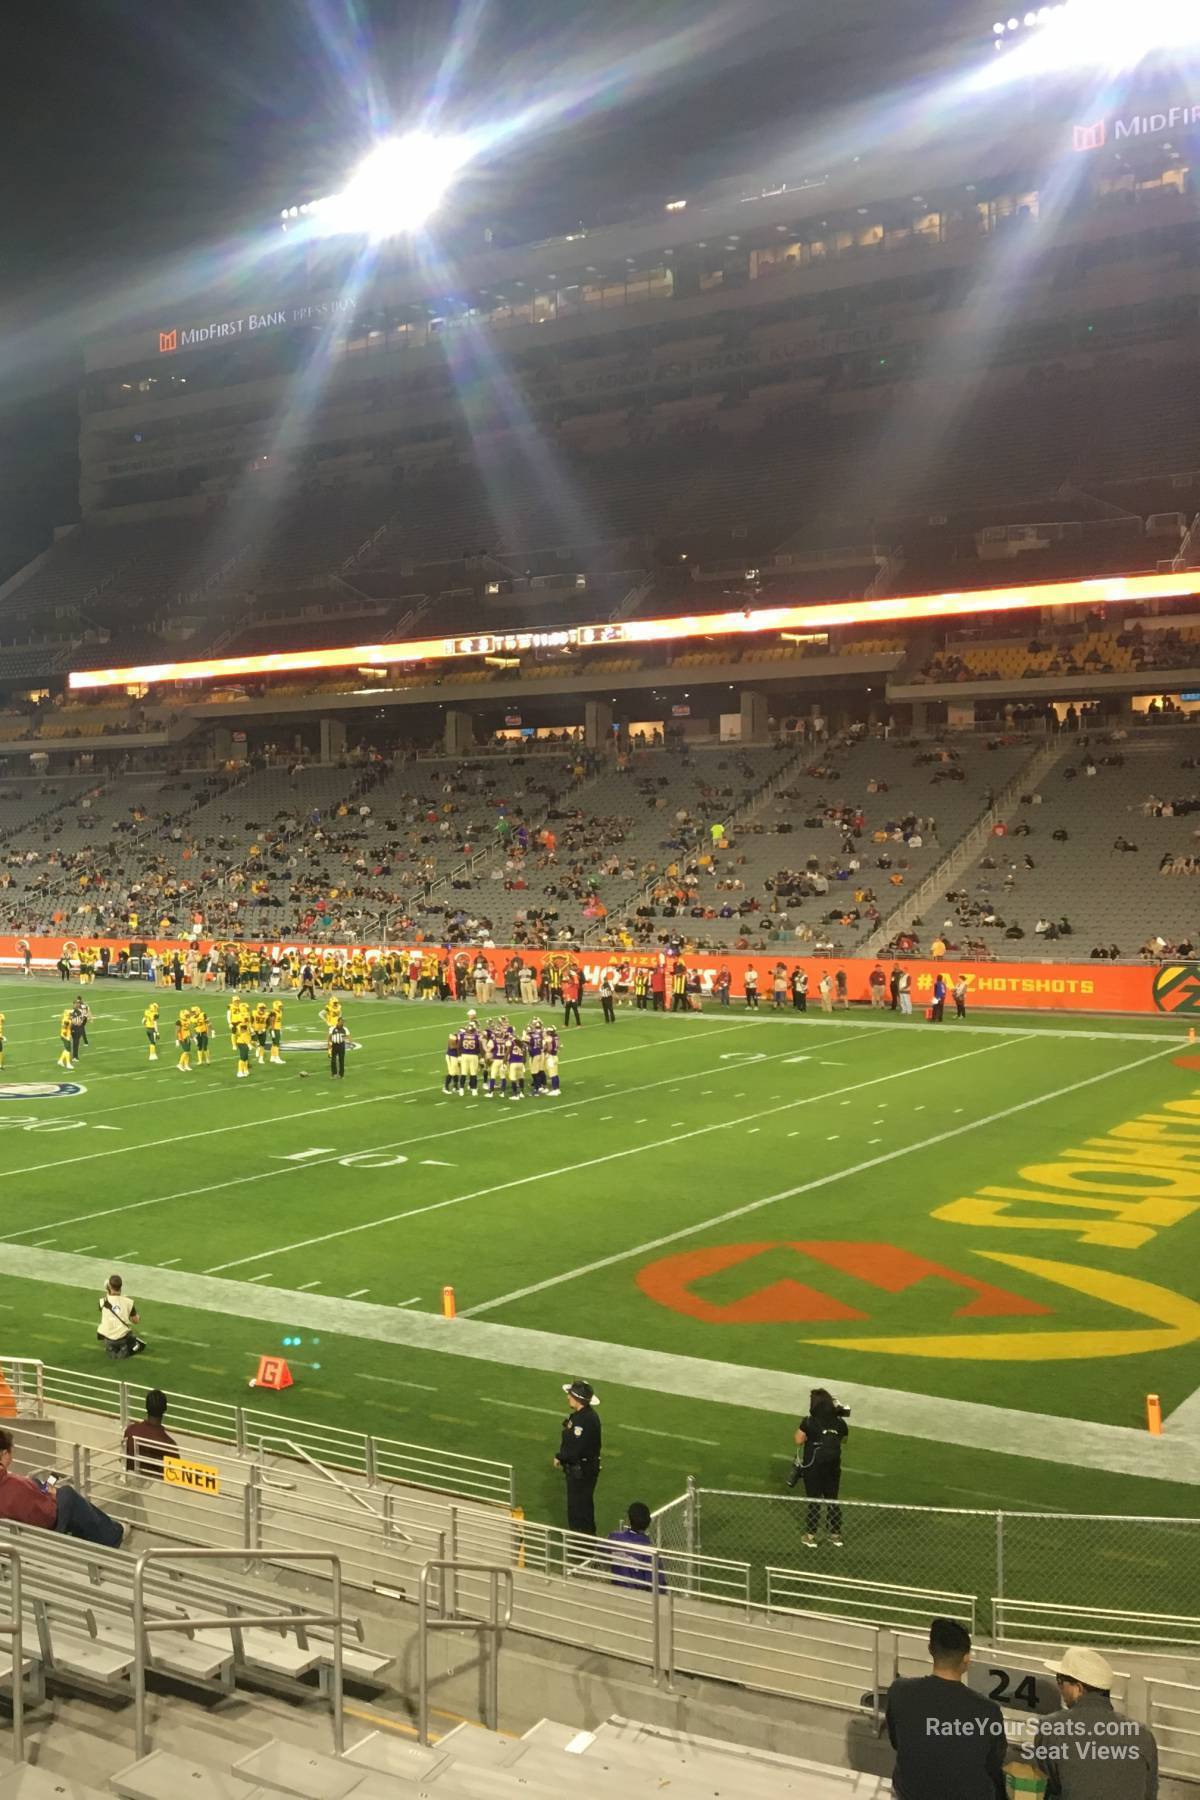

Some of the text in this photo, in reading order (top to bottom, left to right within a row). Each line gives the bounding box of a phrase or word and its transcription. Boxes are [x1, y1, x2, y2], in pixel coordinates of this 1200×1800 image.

[249, 310, 287, 331] BANK
[263, 1360, 282, 1384] G
[988, 1669, 1040, 1709] 24
